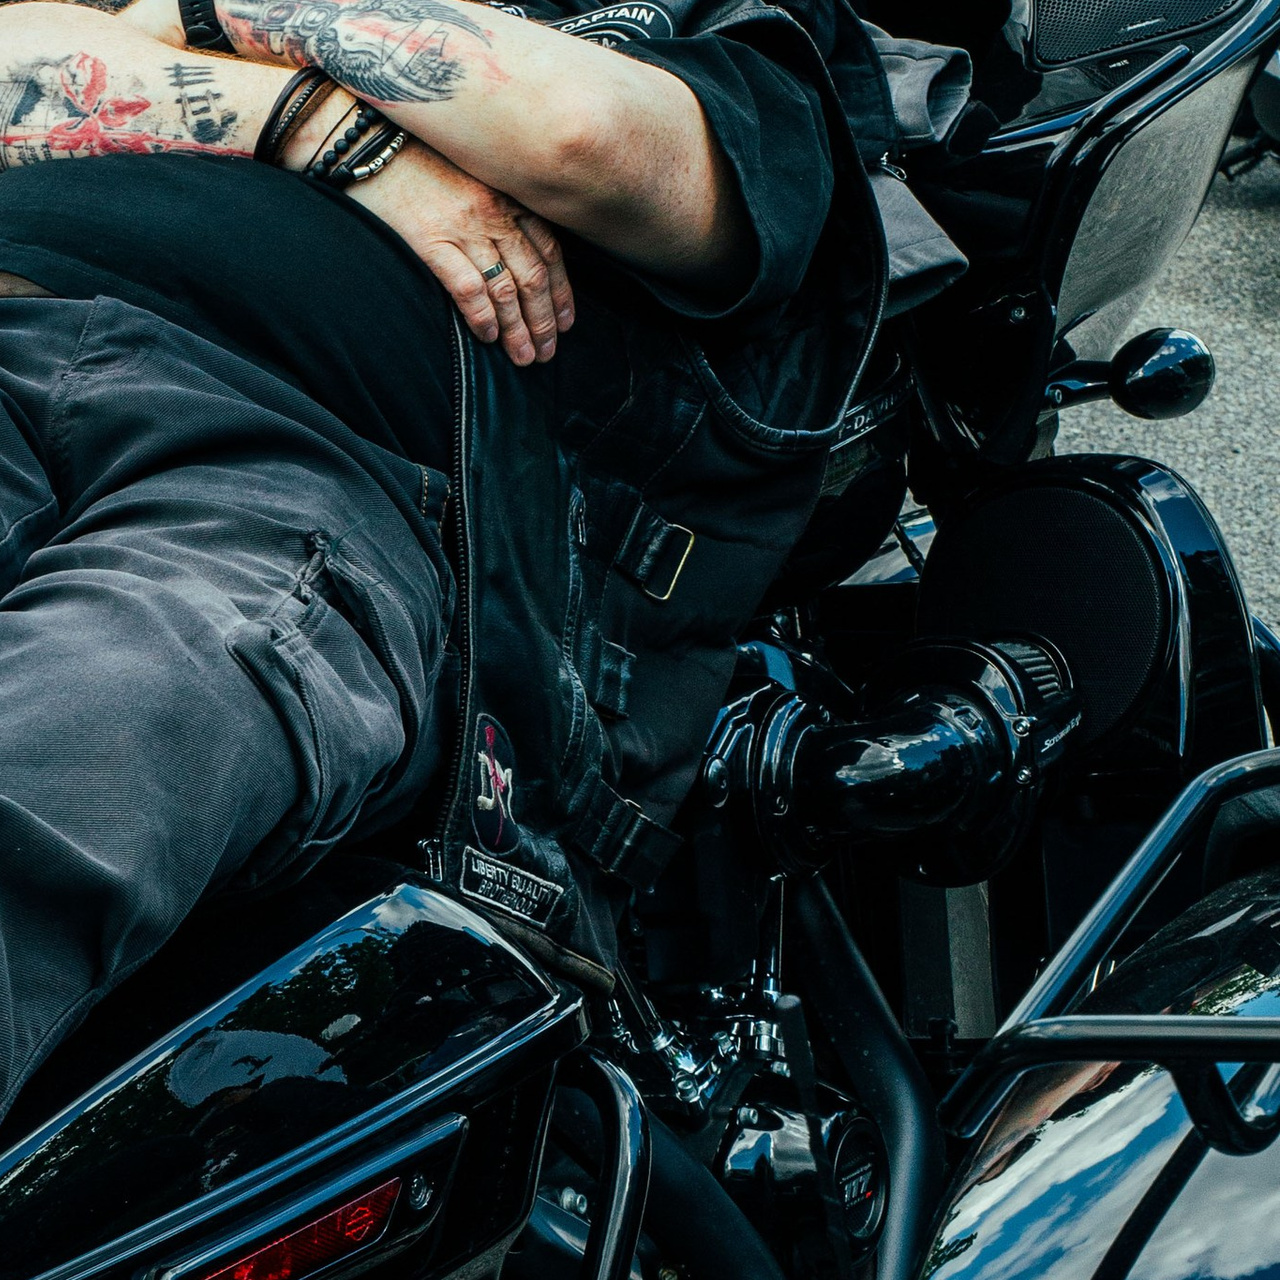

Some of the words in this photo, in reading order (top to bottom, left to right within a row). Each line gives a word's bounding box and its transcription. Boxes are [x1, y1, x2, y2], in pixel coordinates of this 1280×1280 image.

[560, 6, 656, 33] CAPTAIN
[471, 856, 510, 886] LIBERTY
[511, 873, 554, 905] EQUALITY
